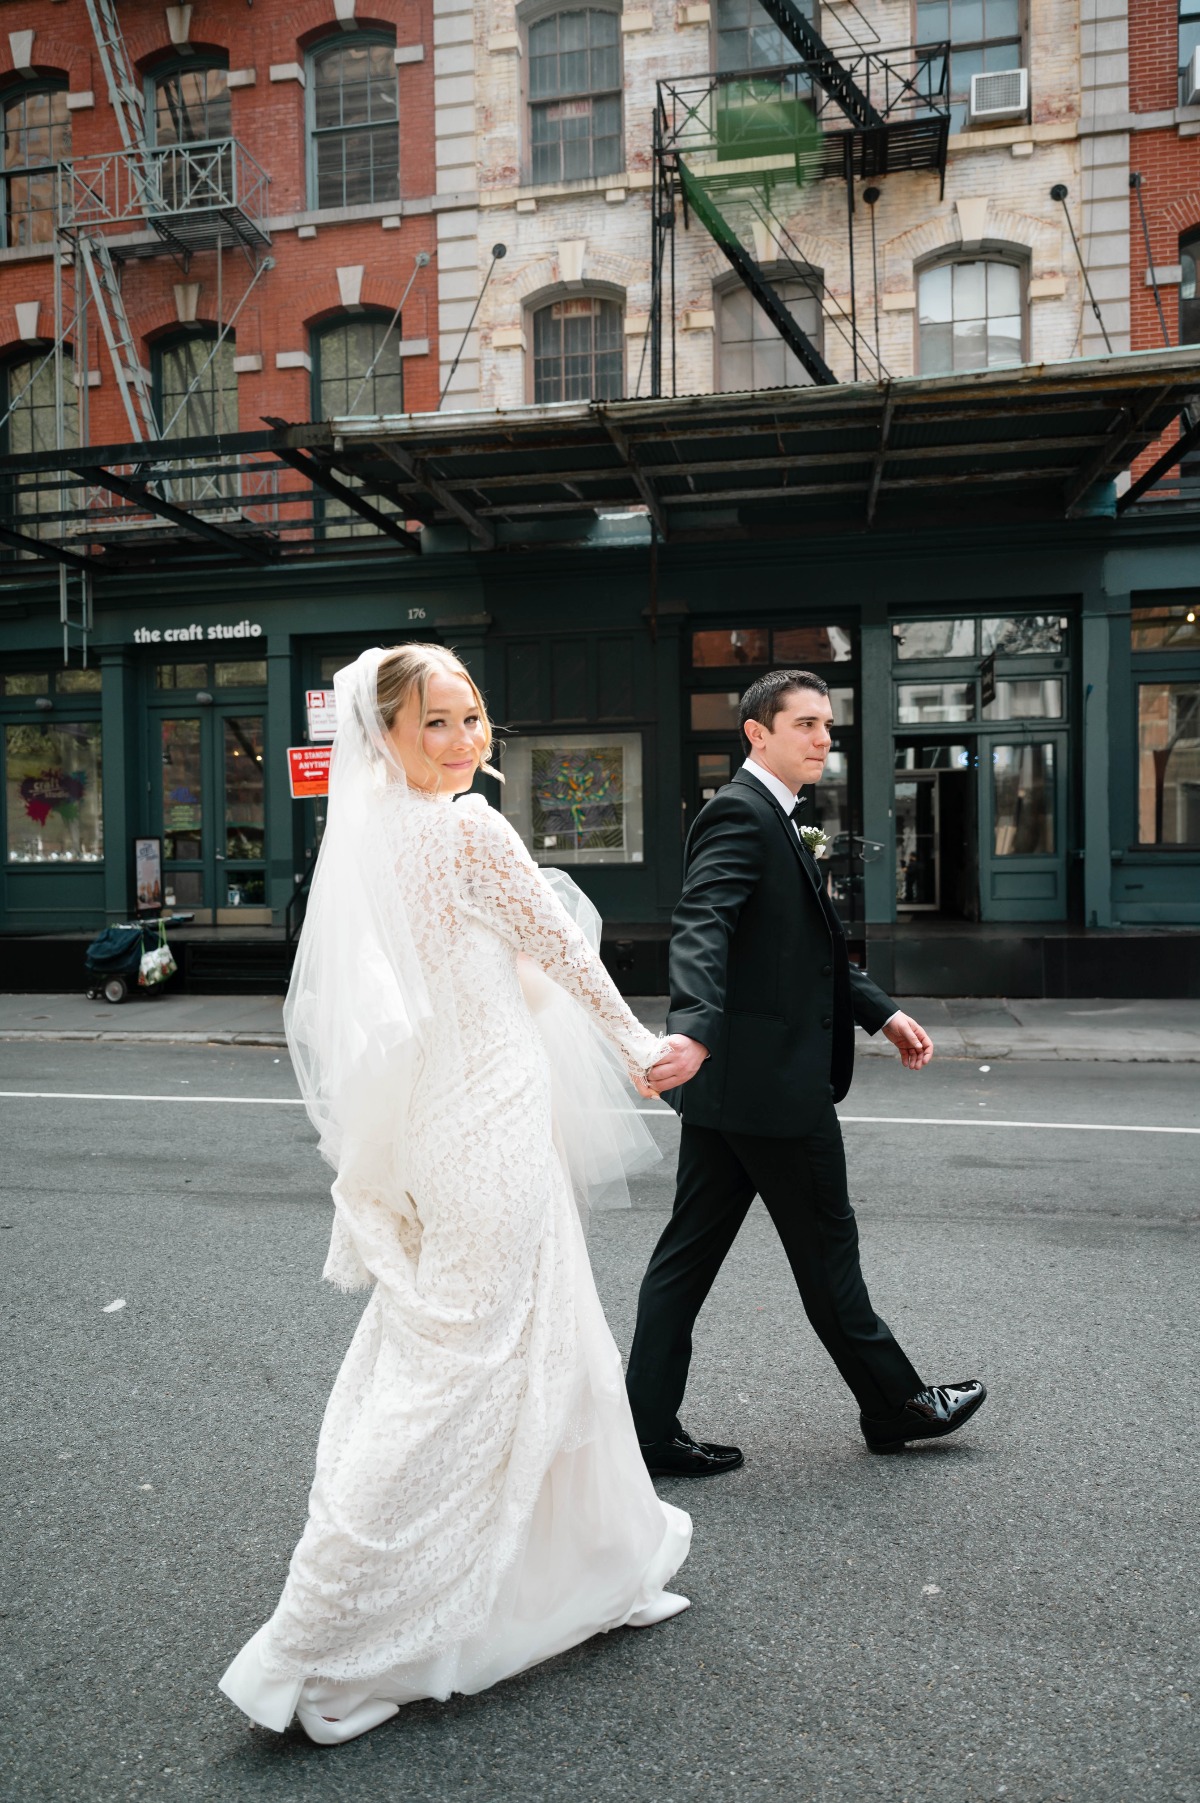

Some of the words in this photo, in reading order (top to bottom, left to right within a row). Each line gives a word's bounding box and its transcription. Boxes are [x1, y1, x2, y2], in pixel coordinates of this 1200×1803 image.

[408, 608, 426, 619] 176
[134, 627, 161, 643] the
[164, 624, 203, 642] craft
[207, 620, 262, 639] studio
[293, 752, 303, 760] NO
[304, 750, 331, 760] STANDIN
[298, 760, 330, 769] ANYTIME
